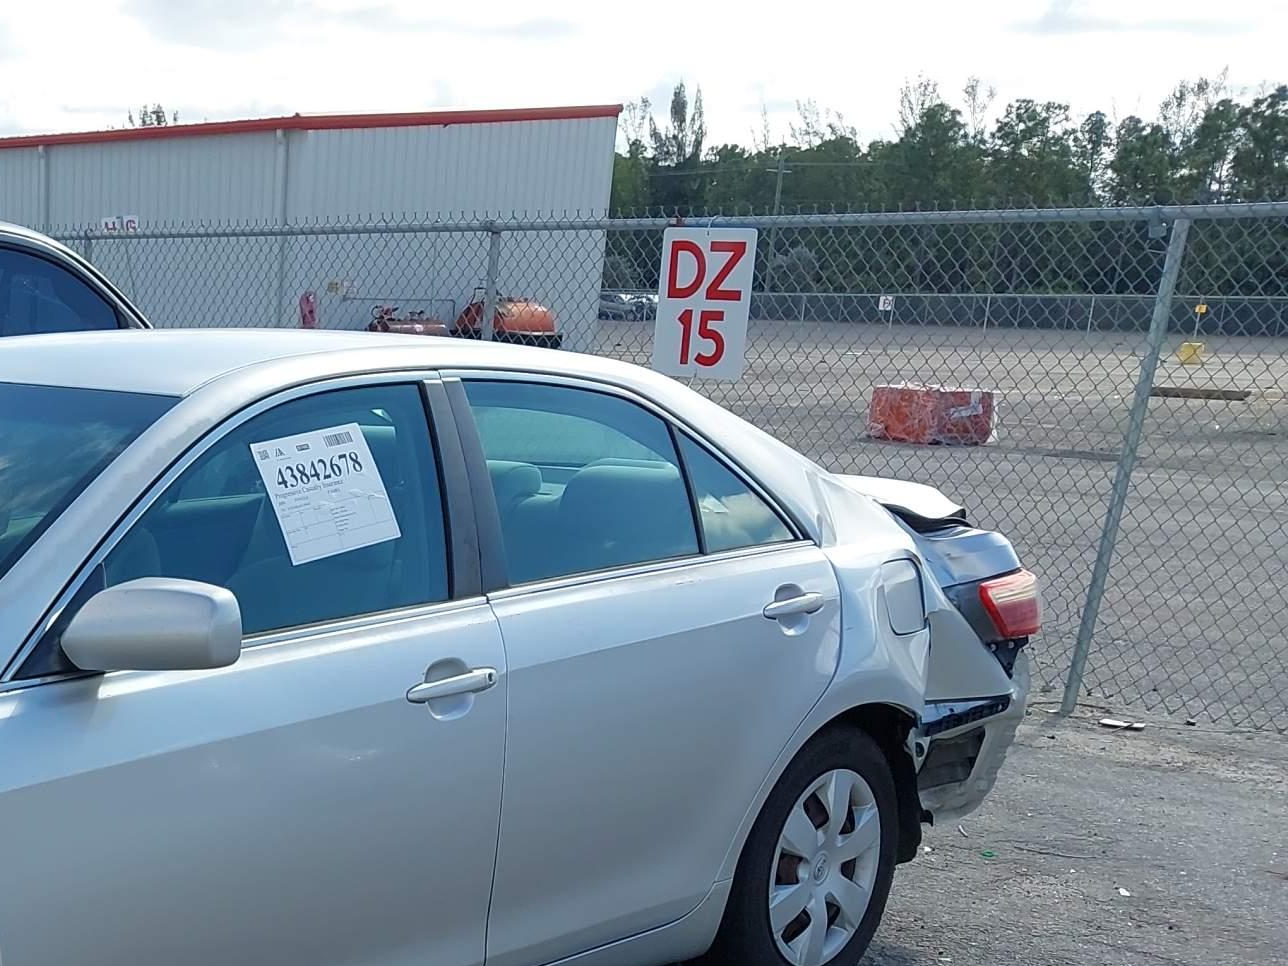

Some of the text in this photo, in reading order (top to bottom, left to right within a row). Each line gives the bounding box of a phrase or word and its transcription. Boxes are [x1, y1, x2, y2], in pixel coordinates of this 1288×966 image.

[667, 240, 747, 301] DZ
[678, 309, 725, 366] 15
[276, 451, 363, 488] 43842678
